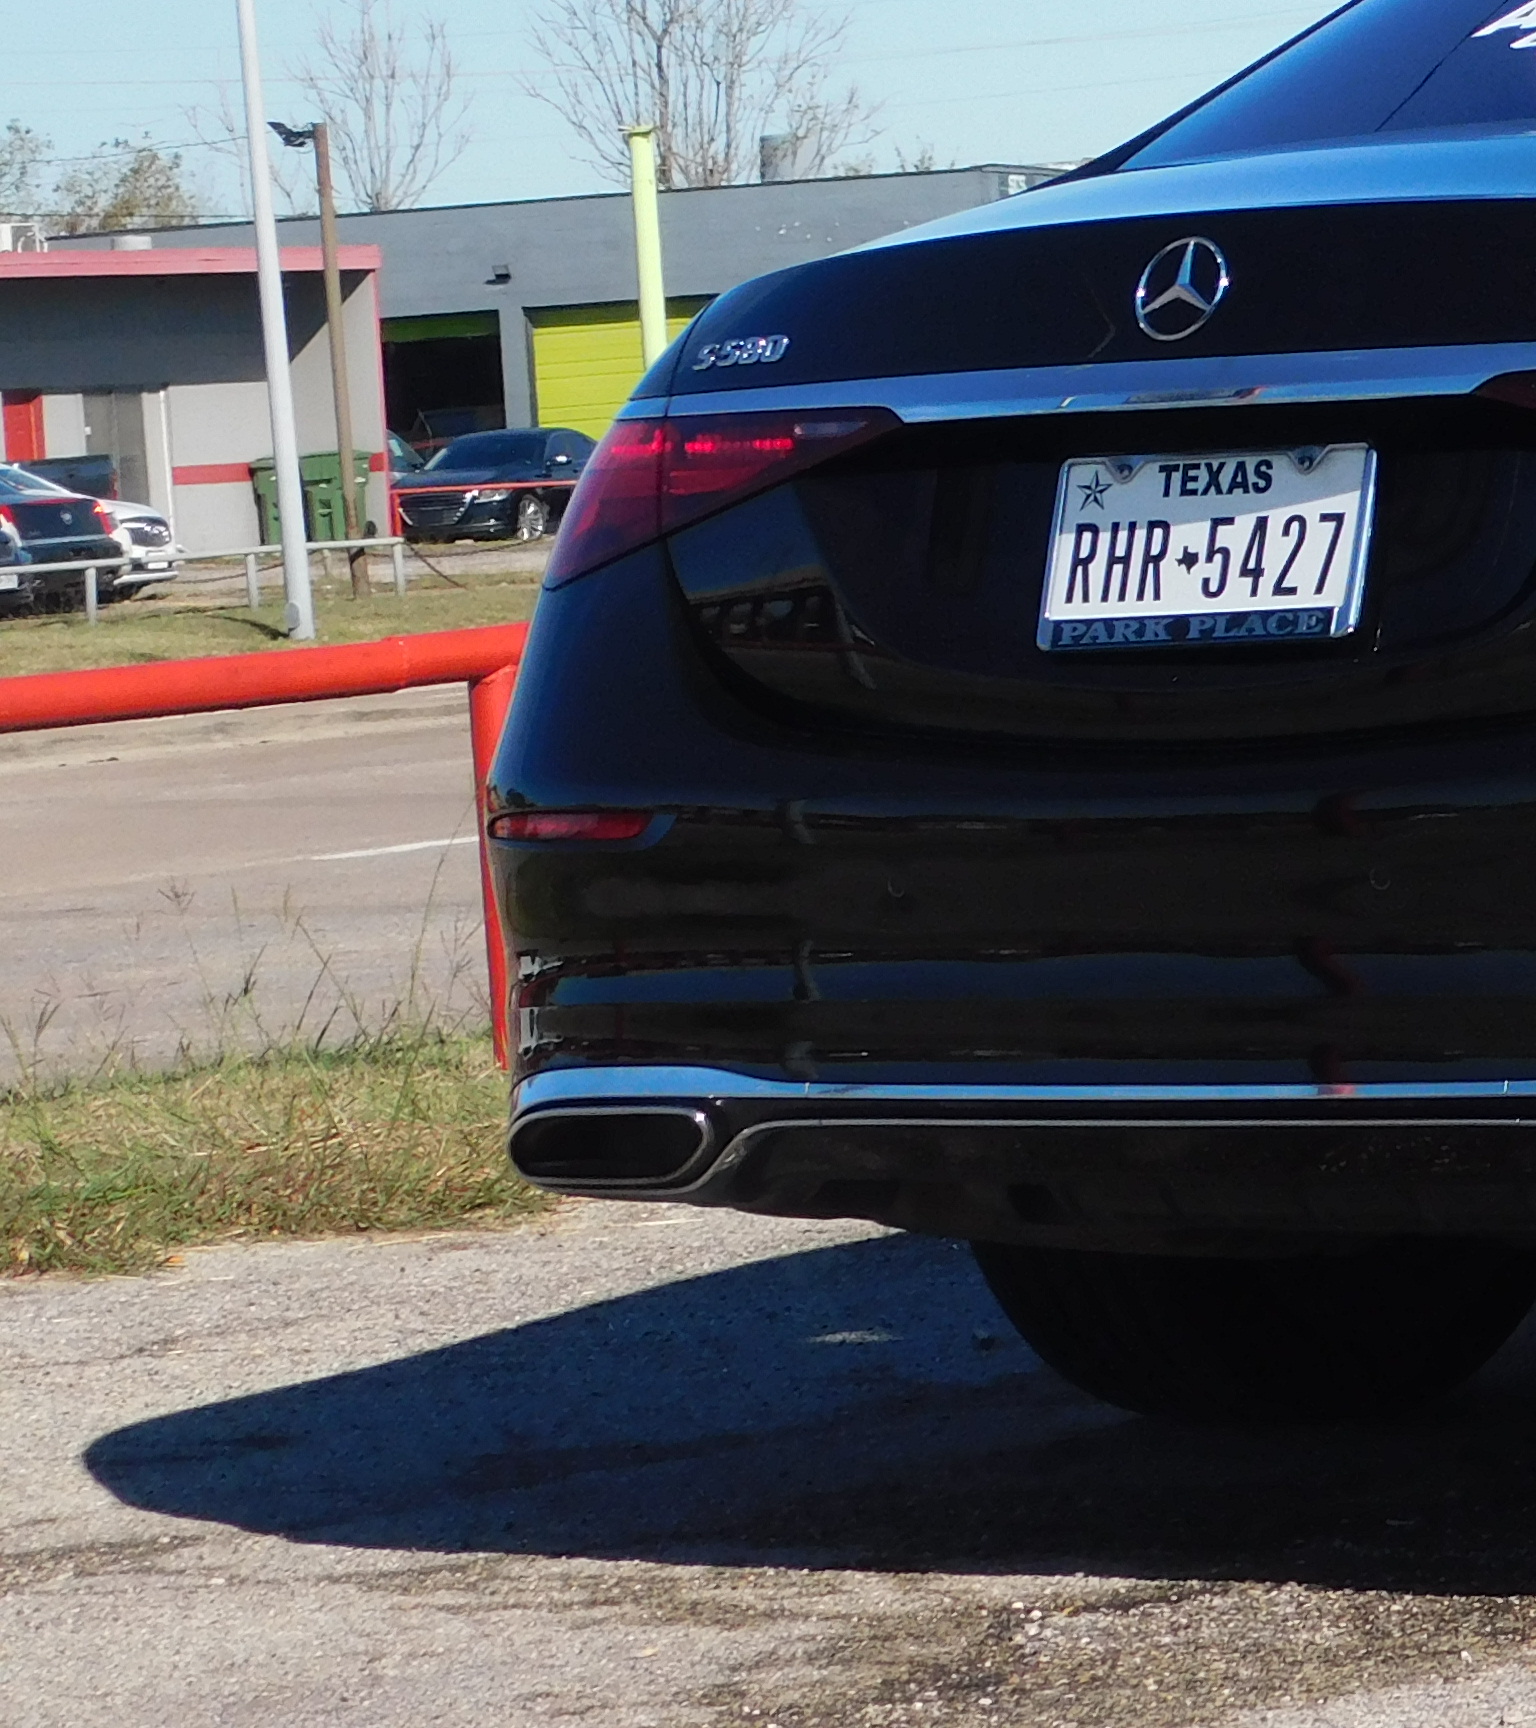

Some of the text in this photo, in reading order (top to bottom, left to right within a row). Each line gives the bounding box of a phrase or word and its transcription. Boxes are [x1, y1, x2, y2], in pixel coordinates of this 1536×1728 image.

[1158, 460, 1273, 498] TEXAS
[1058, 609, 1325, 646] PARK PLACE
